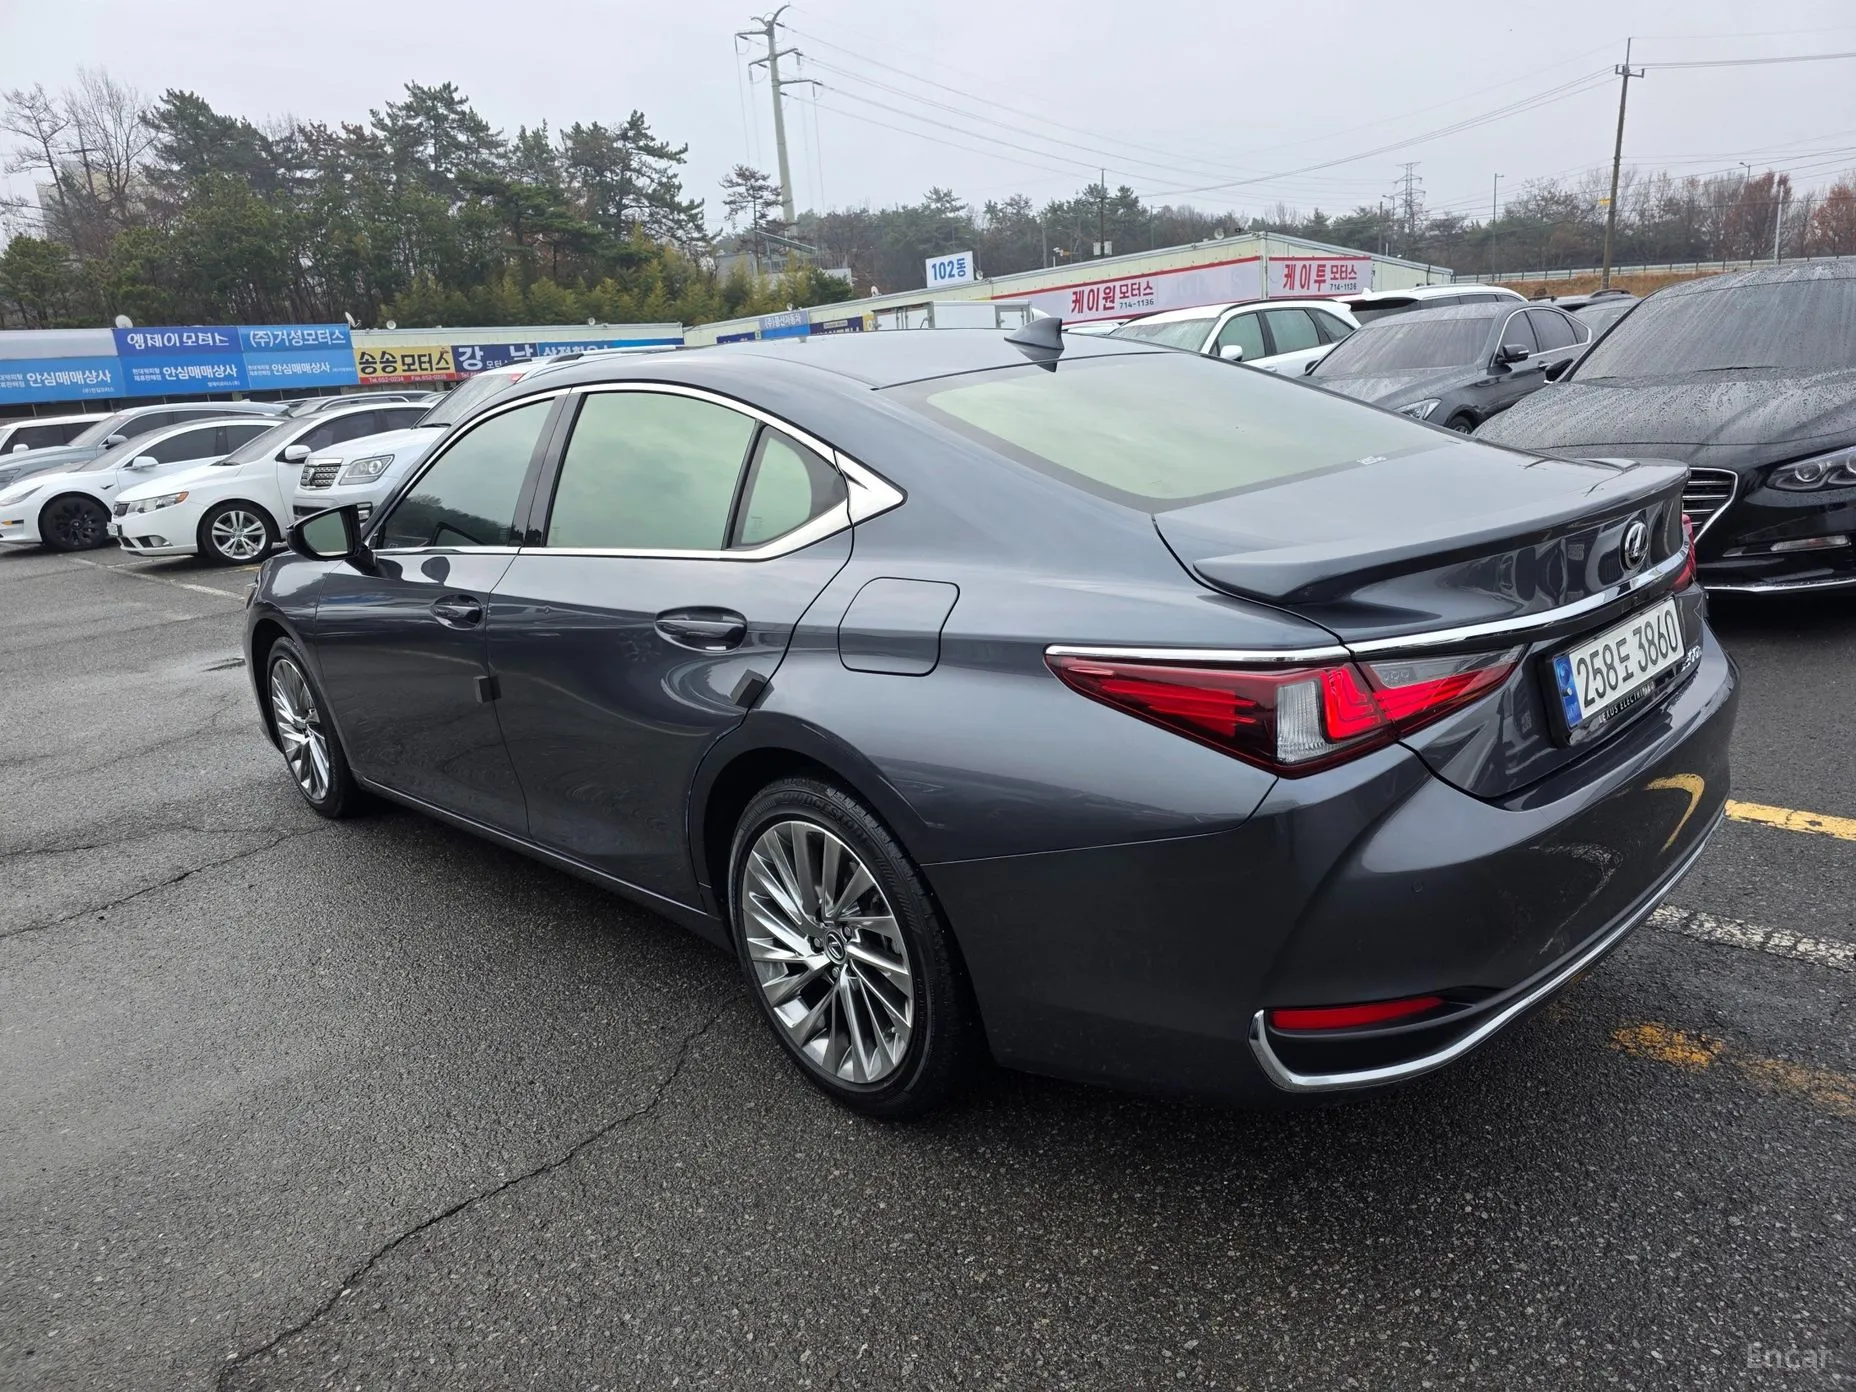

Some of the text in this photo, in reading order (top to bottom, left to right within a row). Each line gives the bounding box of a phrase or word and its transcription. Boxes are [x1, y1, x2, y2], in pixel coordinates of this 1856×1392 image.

[931, 258, 966, 280] 102동
[1283, 264, 1357, 292] 케이투 모터스
[1330, 283, 1357, 291] 714-1136
[1071, 281, 1154, 314] 케이원 모터스
[1119, 299, 1154, 309] 714-1136
[250, 329, 346, 348] (주)거성모터스
[271, 361, 330, 375] 안심매매상사
[358, 350, 451, 375] 송송모터스
[26, 369, 112, 387] 안심매매상사
[163, 364, 237, 381] 안심매매상사
[1576, 637, 1635, 709] 258도
[1632, 609, 1679, 673] 3860
[1598, 704, 1619, 724] LEXUS
